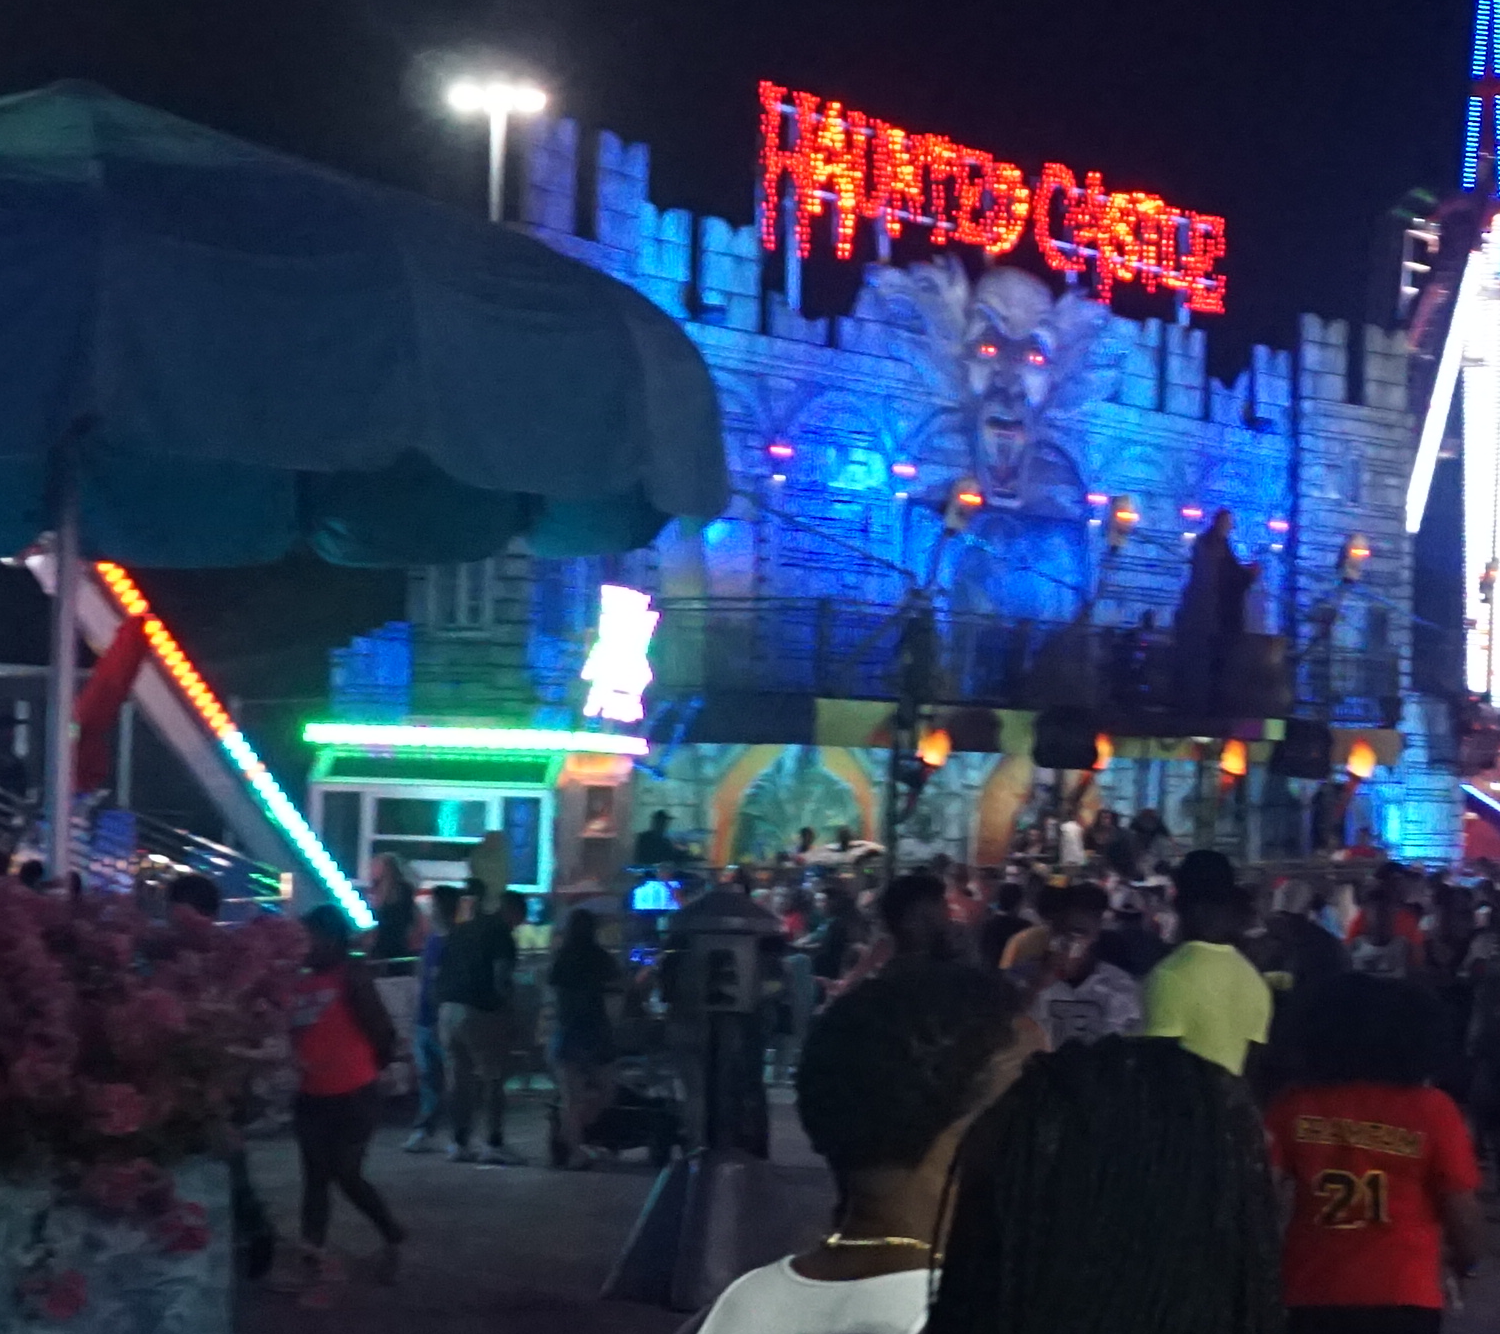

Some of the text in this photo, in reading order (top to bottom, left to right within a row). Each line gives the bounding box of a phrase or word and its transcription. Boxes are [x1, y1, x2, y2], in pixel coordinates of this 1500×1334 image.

[759, 80, 1226, 314] HAUNTED CASTLE
[1311, 1168, 1392, 1230] 21
